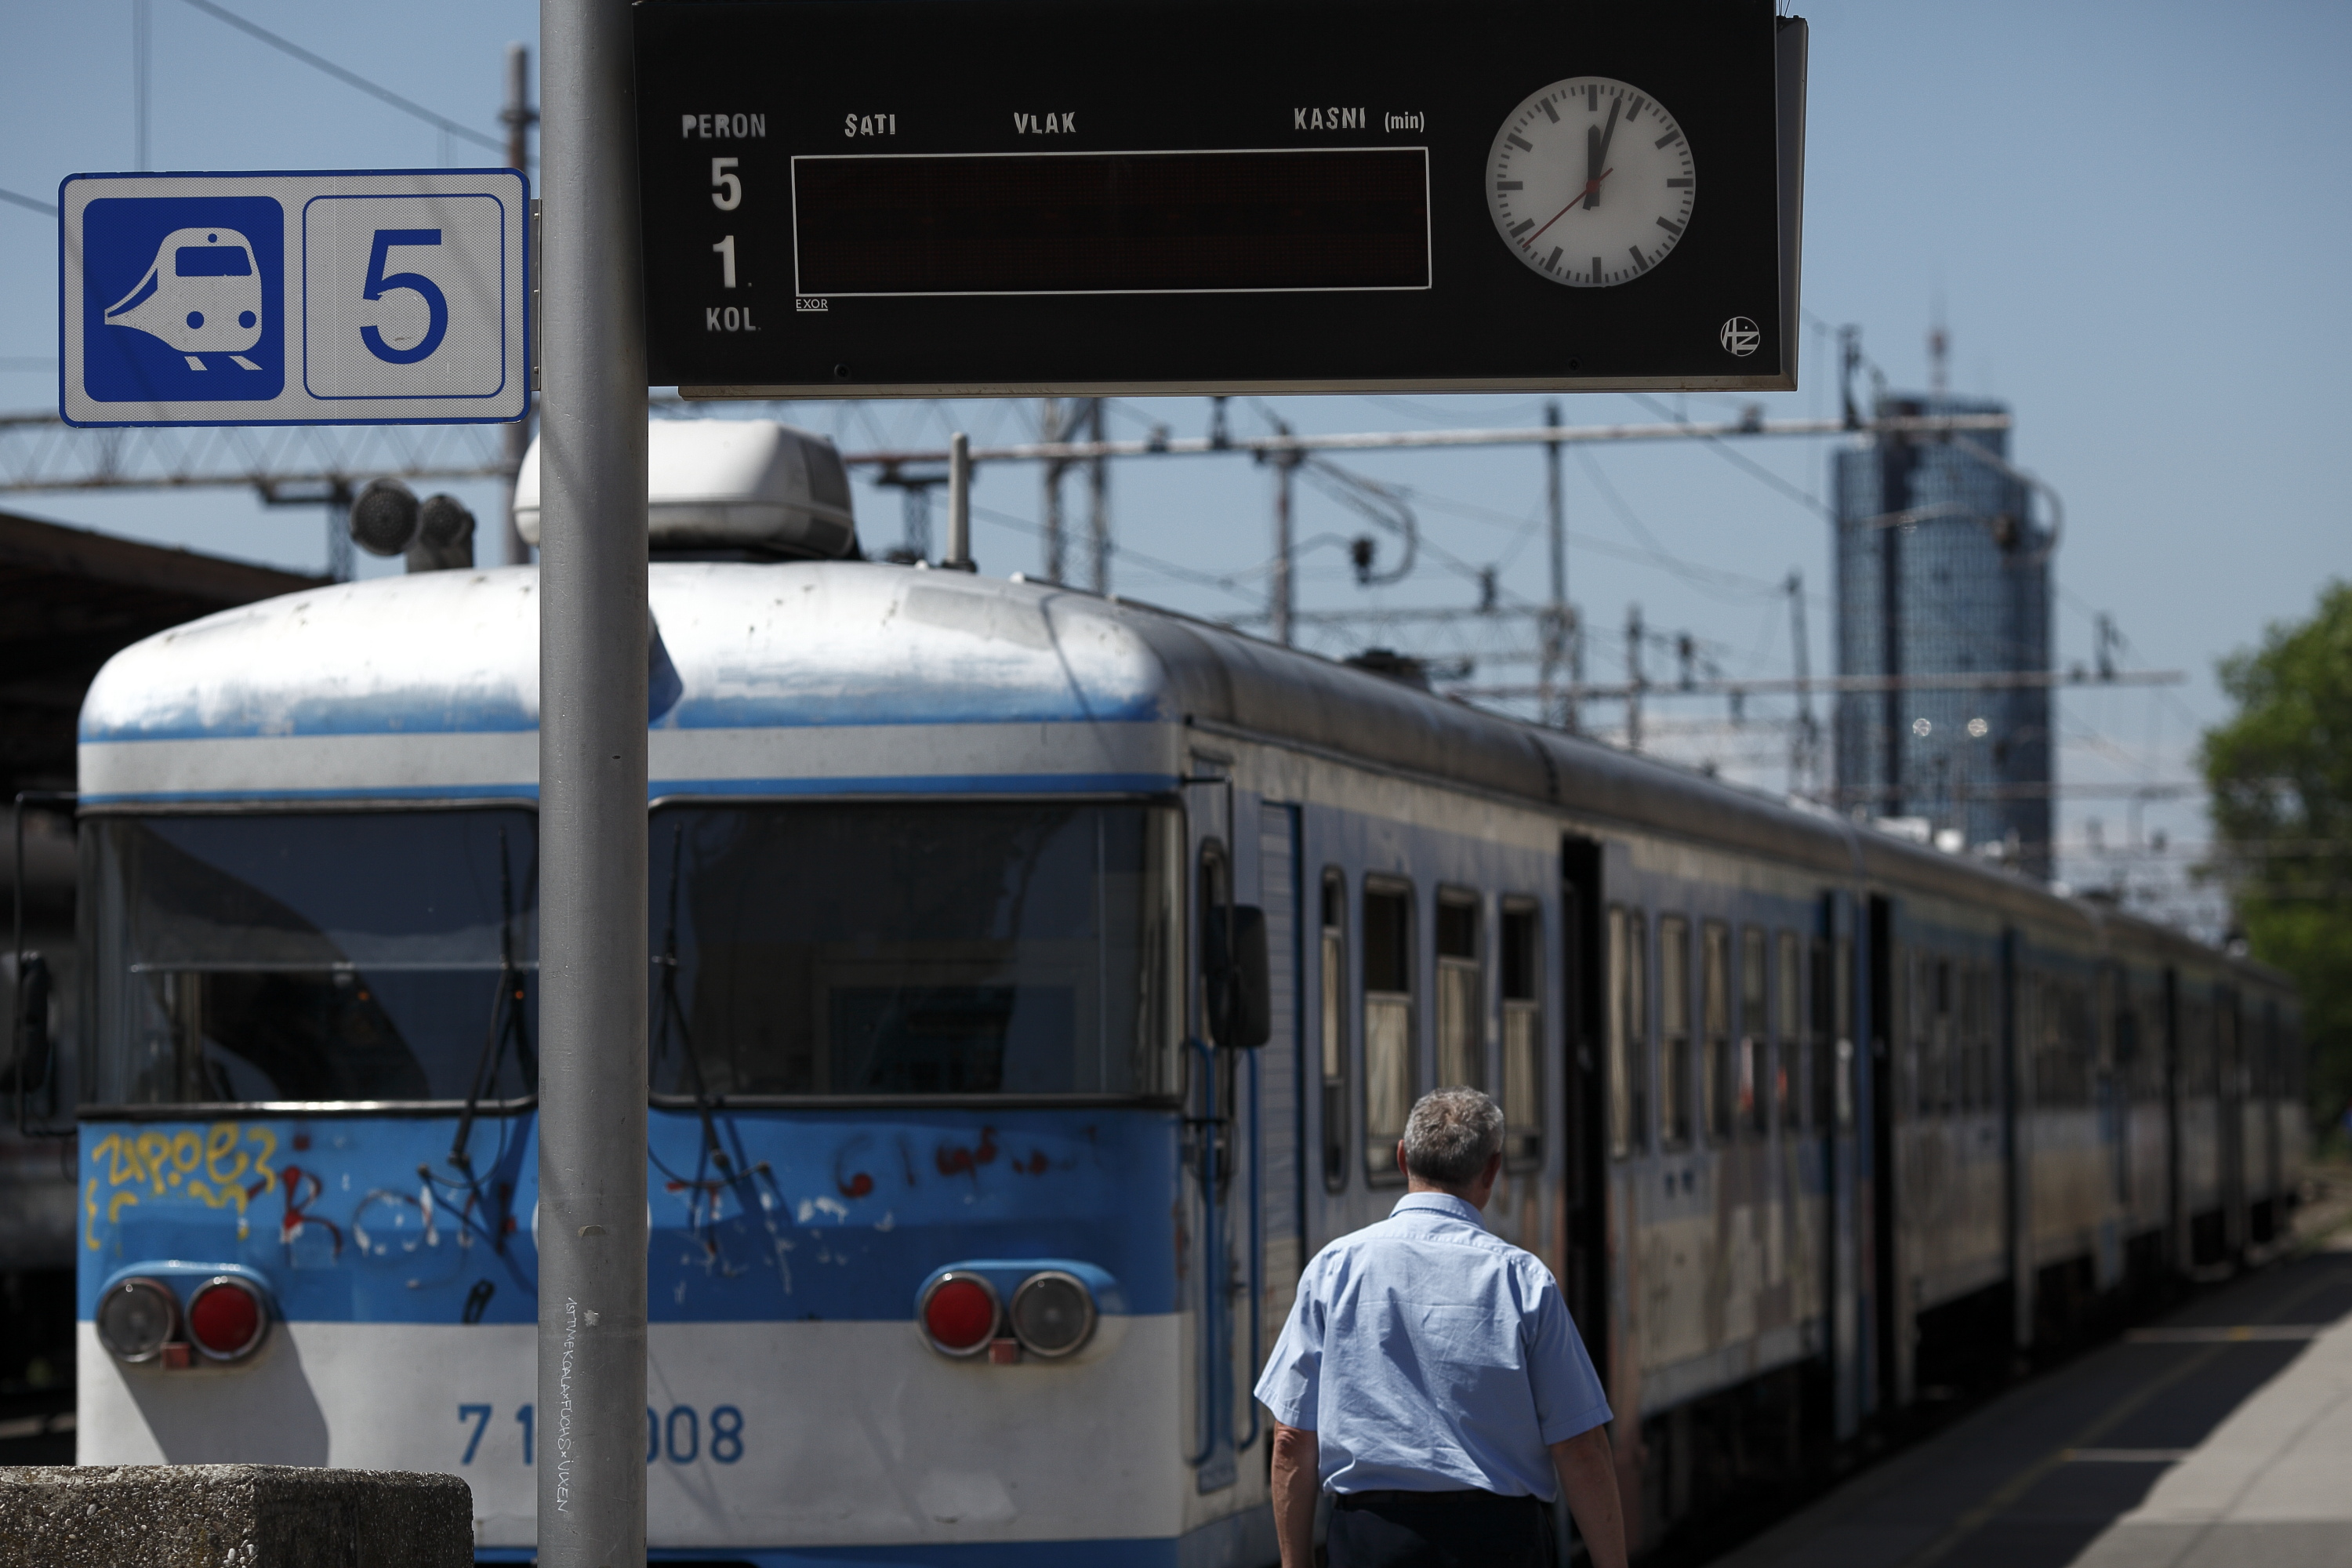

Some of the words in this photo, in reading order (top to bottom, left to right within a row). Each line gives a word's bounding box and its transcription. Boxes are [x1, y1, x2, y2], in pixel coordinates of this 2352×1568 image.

[682, 113, 766, 138] PERON
[844, 113, 896, 137] SATI
[1014, 111, 1076, 134] VLAK
[1294, 107, 1366, 130] KASNI
[1385, 111, 1425, 133] (min)
[711, 157, 742, 211] 5
[360, 229, 448, 365] 5
[796, 299, 828, 311] EXOR
